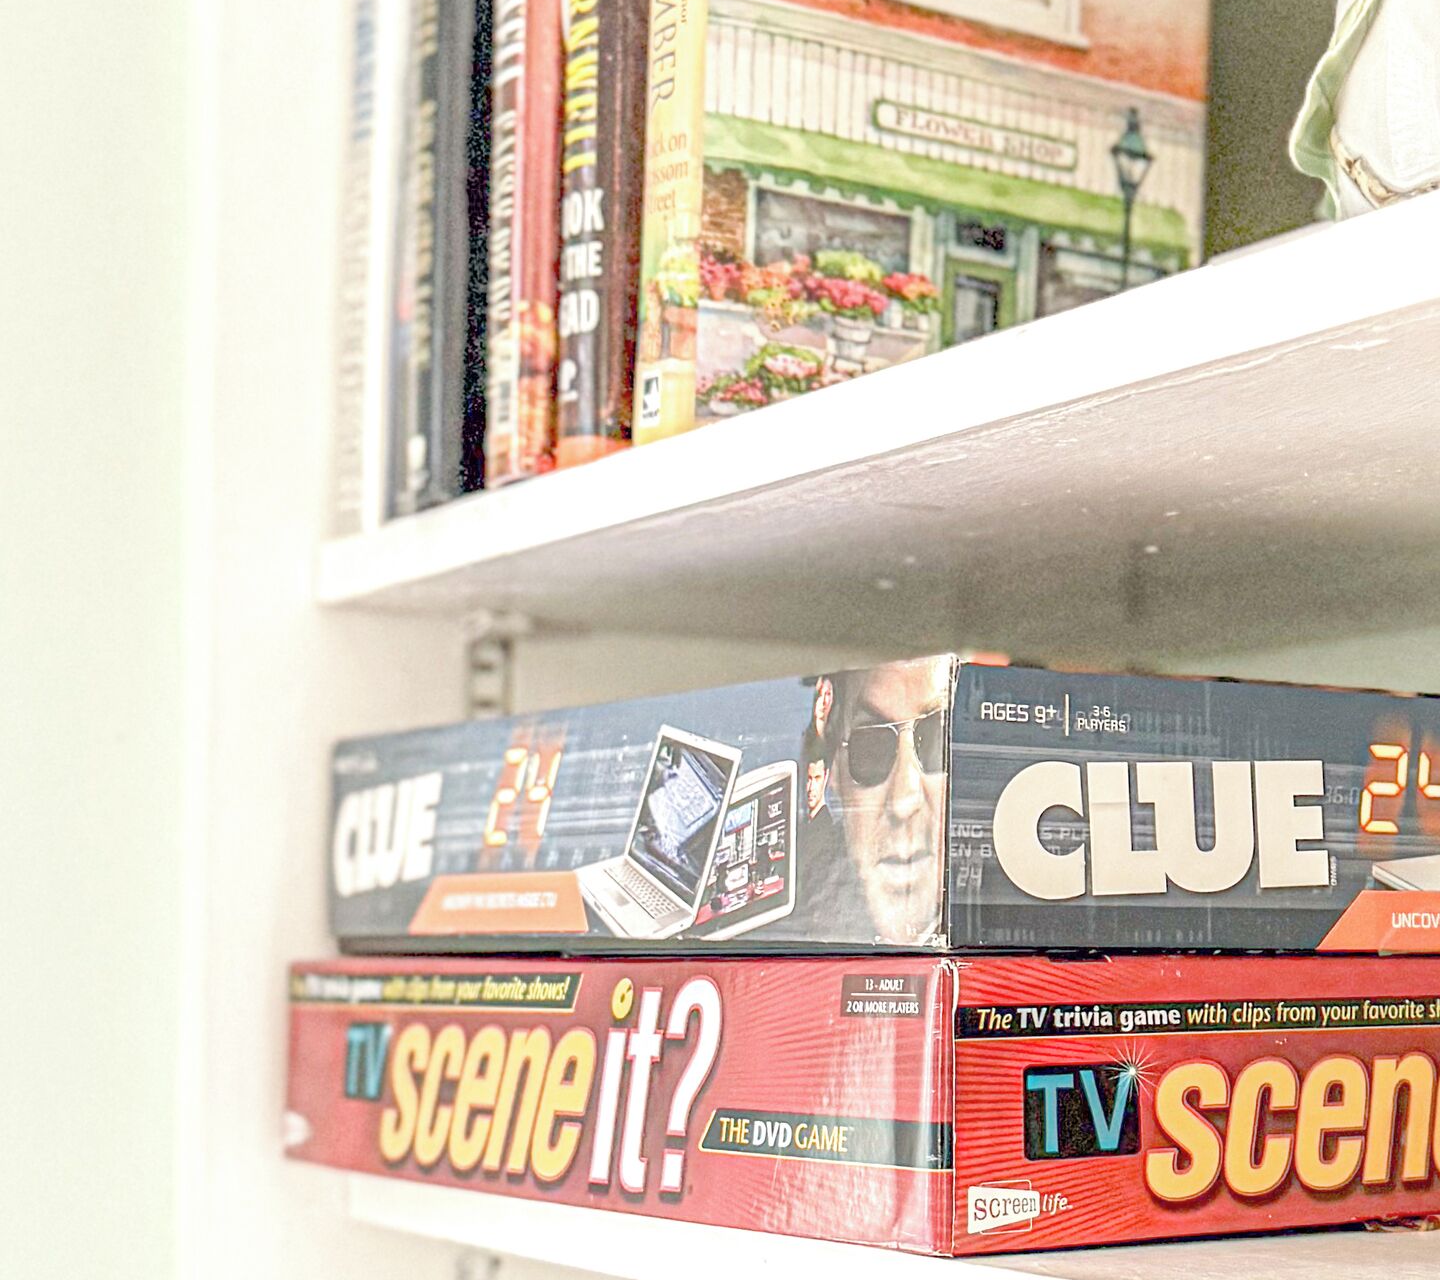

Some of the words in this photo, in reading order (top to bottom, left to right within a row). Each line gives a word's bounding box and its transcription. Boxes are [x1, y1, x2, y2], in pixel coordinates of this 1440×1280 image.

[981, 701, 1029, 723] AGES
[1034, 704, 1058, 724] 9+
[1077, 716, 1127, 732] PLAYERS
[483, 747, 563, 848] 24
[333, 771, 443, 898] CLUE
[992, 759, 1331, 900] CLUE
[482, 976, 527, 1001] favorite
[527, 975, 571, 1001] shows!
[879, 979, 904, 991] ADULT
[865, 1001, 887, 1013] MORE
[978, 1008, 1013, 1031] The
[1016, 1007, 1048, 1030] TV
[1053, 1008, 1113, 1029] trivia
[1119, 1007, 1181, 1030] game
[1187, 1002, 1228, 1025] with
[1232, 1001, 1273, 1028] clips
[1276, 1001, 1317, 1025] from
[1320, 1004, 1360, 1024] your
[1363, 1000, 1425, 1022] favorite
[343, 1023, 391, 1100] TV
[380, 1022, 598, 1184] scene
[1026, 1070, 1133, 1154] TV
[719, 1117, 749, 1145] THE
[752, 1119, 792, 1148] DVD
